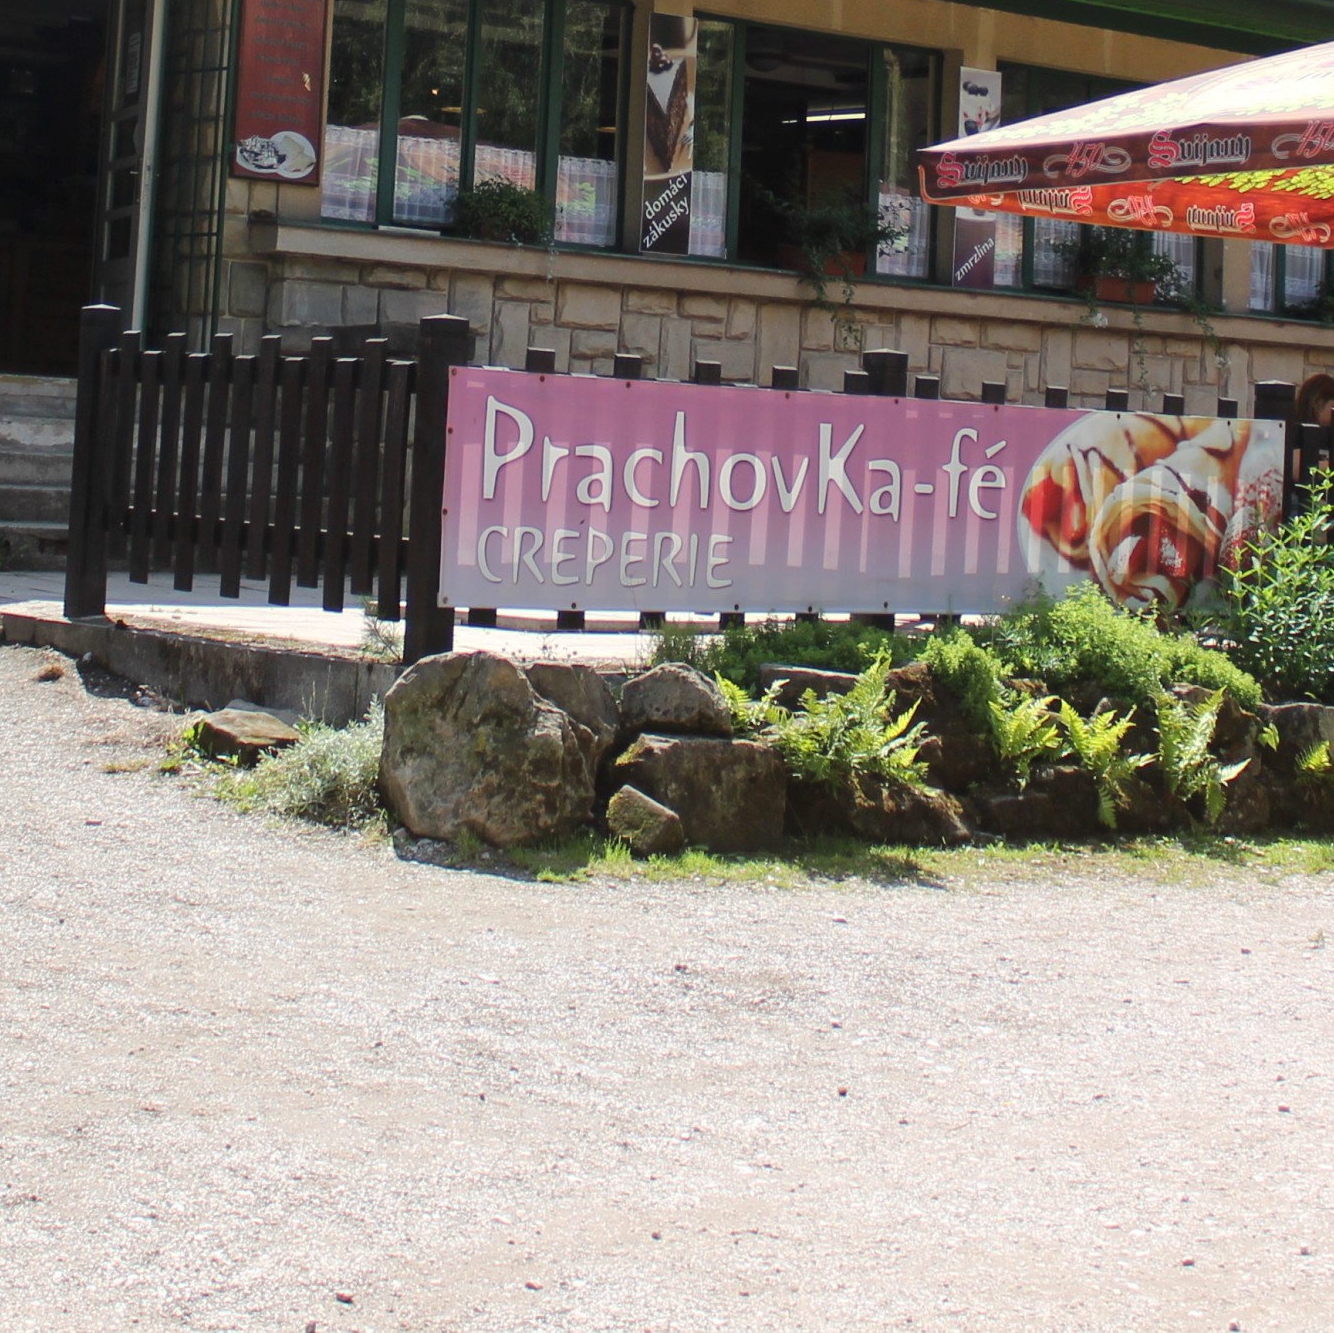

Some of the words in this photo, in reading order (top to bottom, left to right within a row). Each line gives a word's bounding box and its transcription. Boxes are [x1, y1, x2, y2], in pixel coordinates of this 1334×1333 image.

[936, 151, 1028, 188] Svijany
[1148, 129, 1251, 169] Svijany
[643, 197, 689, 248] zákusky
[955, 237, 994, 281] zmrzlina
[482, 394, 1008, 523] PrachovKa-fé
